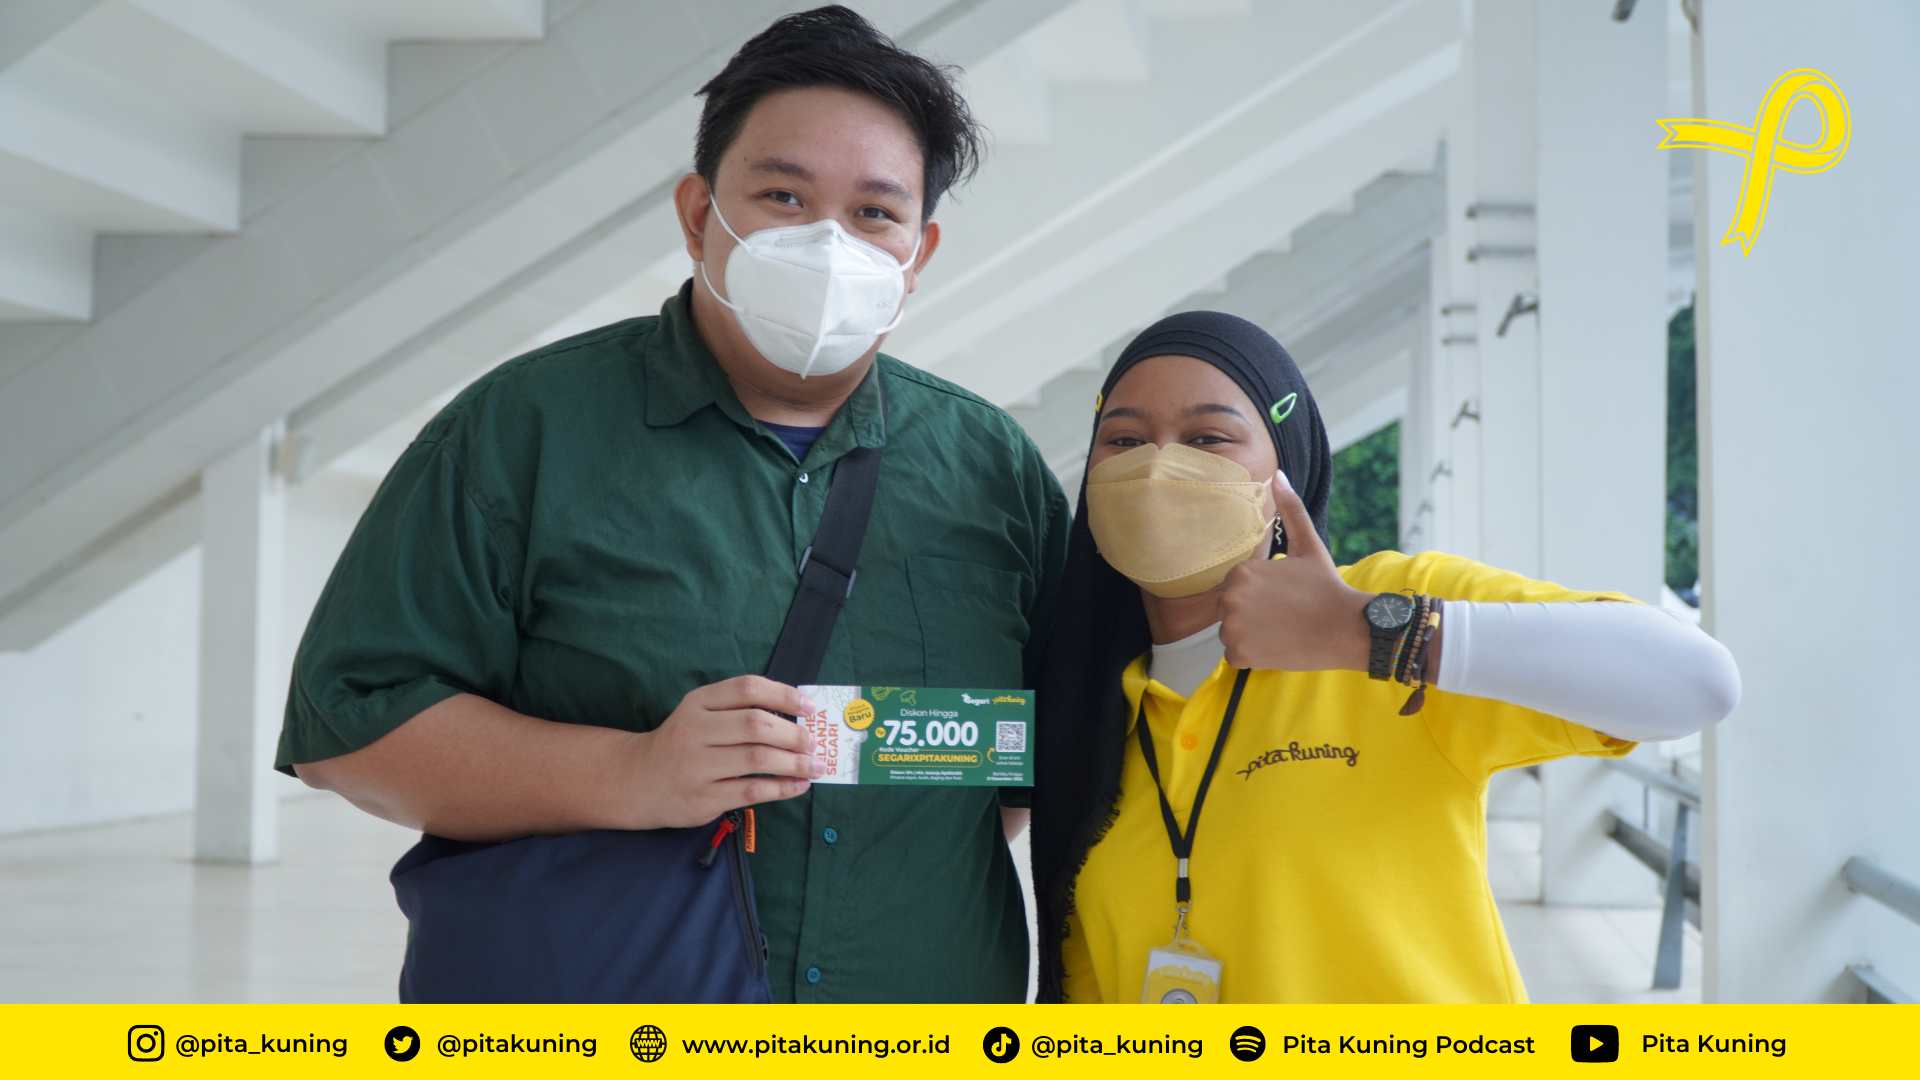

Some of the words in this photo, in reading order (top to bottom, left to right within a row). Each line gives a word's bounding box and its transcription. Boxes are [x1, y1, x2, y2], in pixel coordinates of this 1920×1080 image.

[849, 712, 872, 723] Baru
[901, 709, 928, 717] Diskon
[929, 710, 958, 719] Hingga
[816, 709, 827, 762] LANJA
[883, 720, 979, 747] 75.000
[827, 724, 838, 775] SEGARI
[878, 753, 977, 763] SEGARIXPITAKUNING
